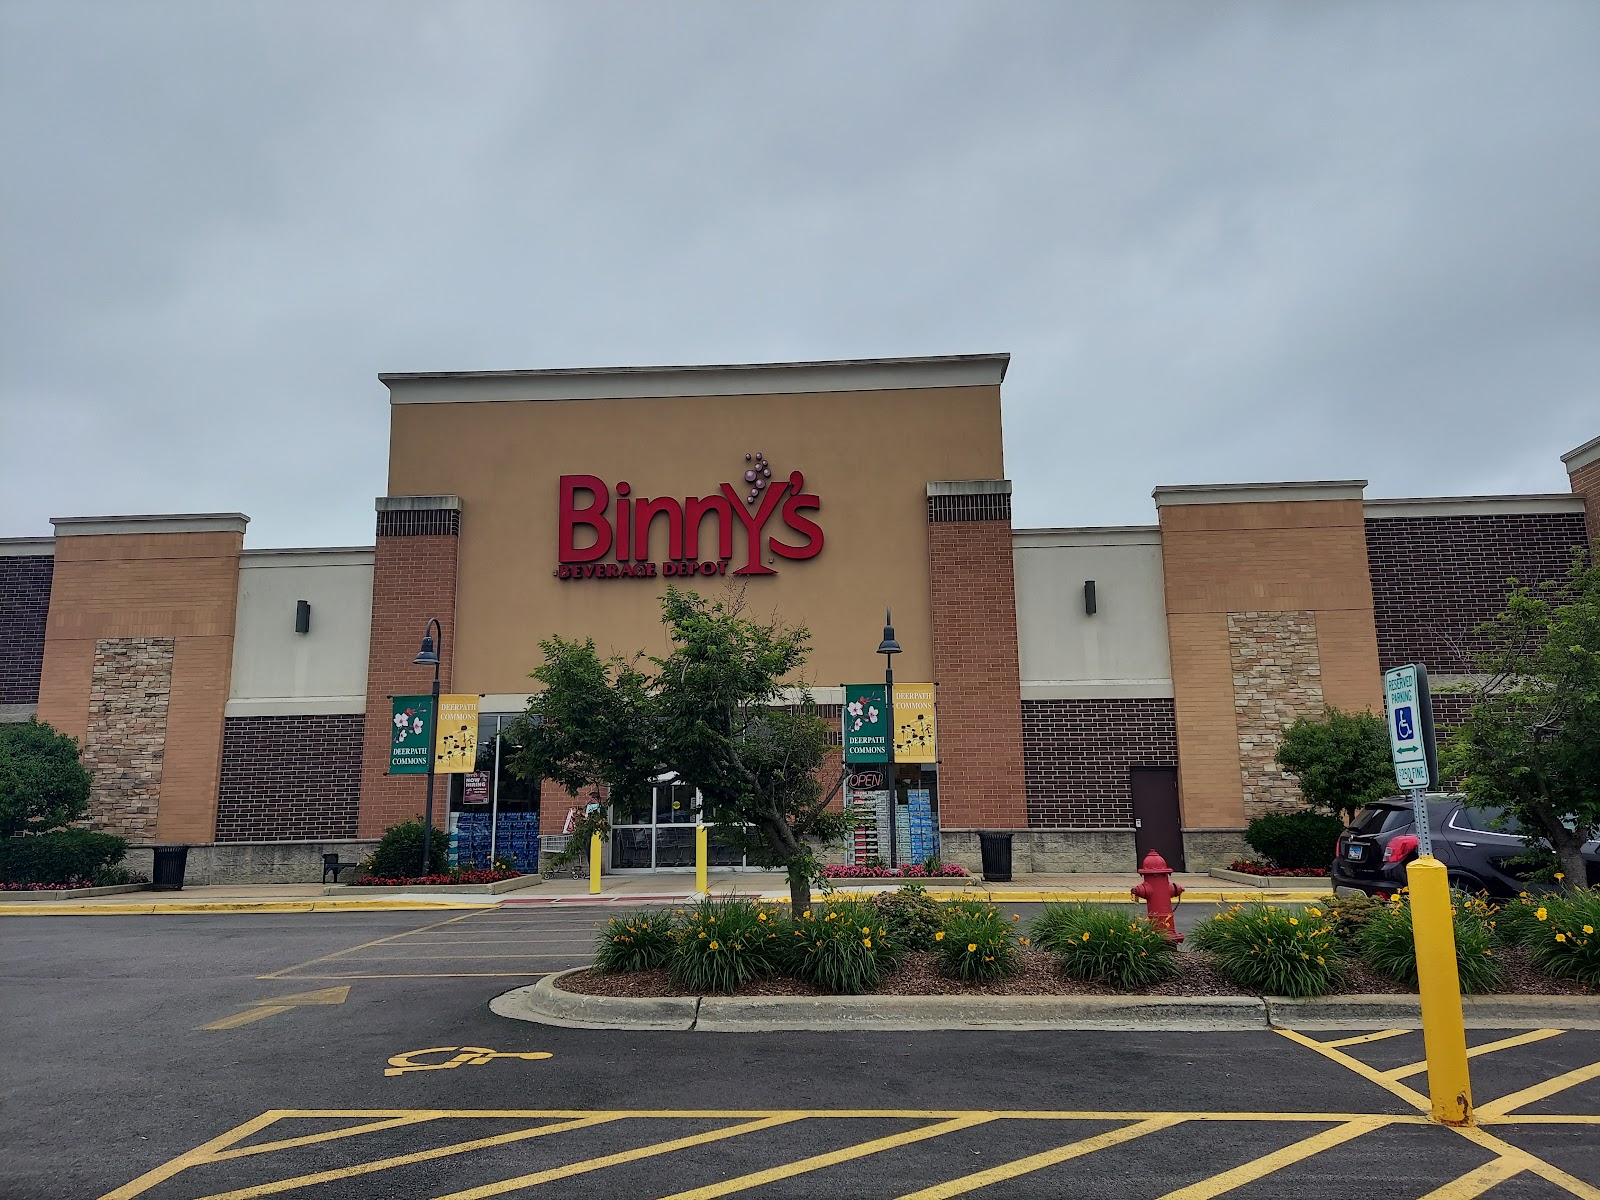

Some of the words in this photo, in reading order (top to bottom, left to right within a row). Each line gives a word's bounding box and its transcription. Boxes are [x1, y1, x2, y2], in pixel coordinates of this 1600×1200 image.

[557, 562, 657, 579] BEVERAGE
[662, 560, 729, 577] DEPOT
[1388, 675, 1413, 691] RESERVED
[896, 692, 932, 700] DEERPATH
[1391, 689, 1412, 704] PARKING
[441, 703, 477, 711] DEERPATH
[895, 701, 932, 710] COMMONS
[440, 712, 476, 721] COMMONS
[849, 736, 885, 745] DEERPATH
[393, 747, 427, 756] DEERPATH
[849, 746, 886, 754] COMMONS
[392, 757, 427, 766] COMMONS
[1412, 766, 1425, 779] FINE
[849, 774, 881, 787] OPEN
